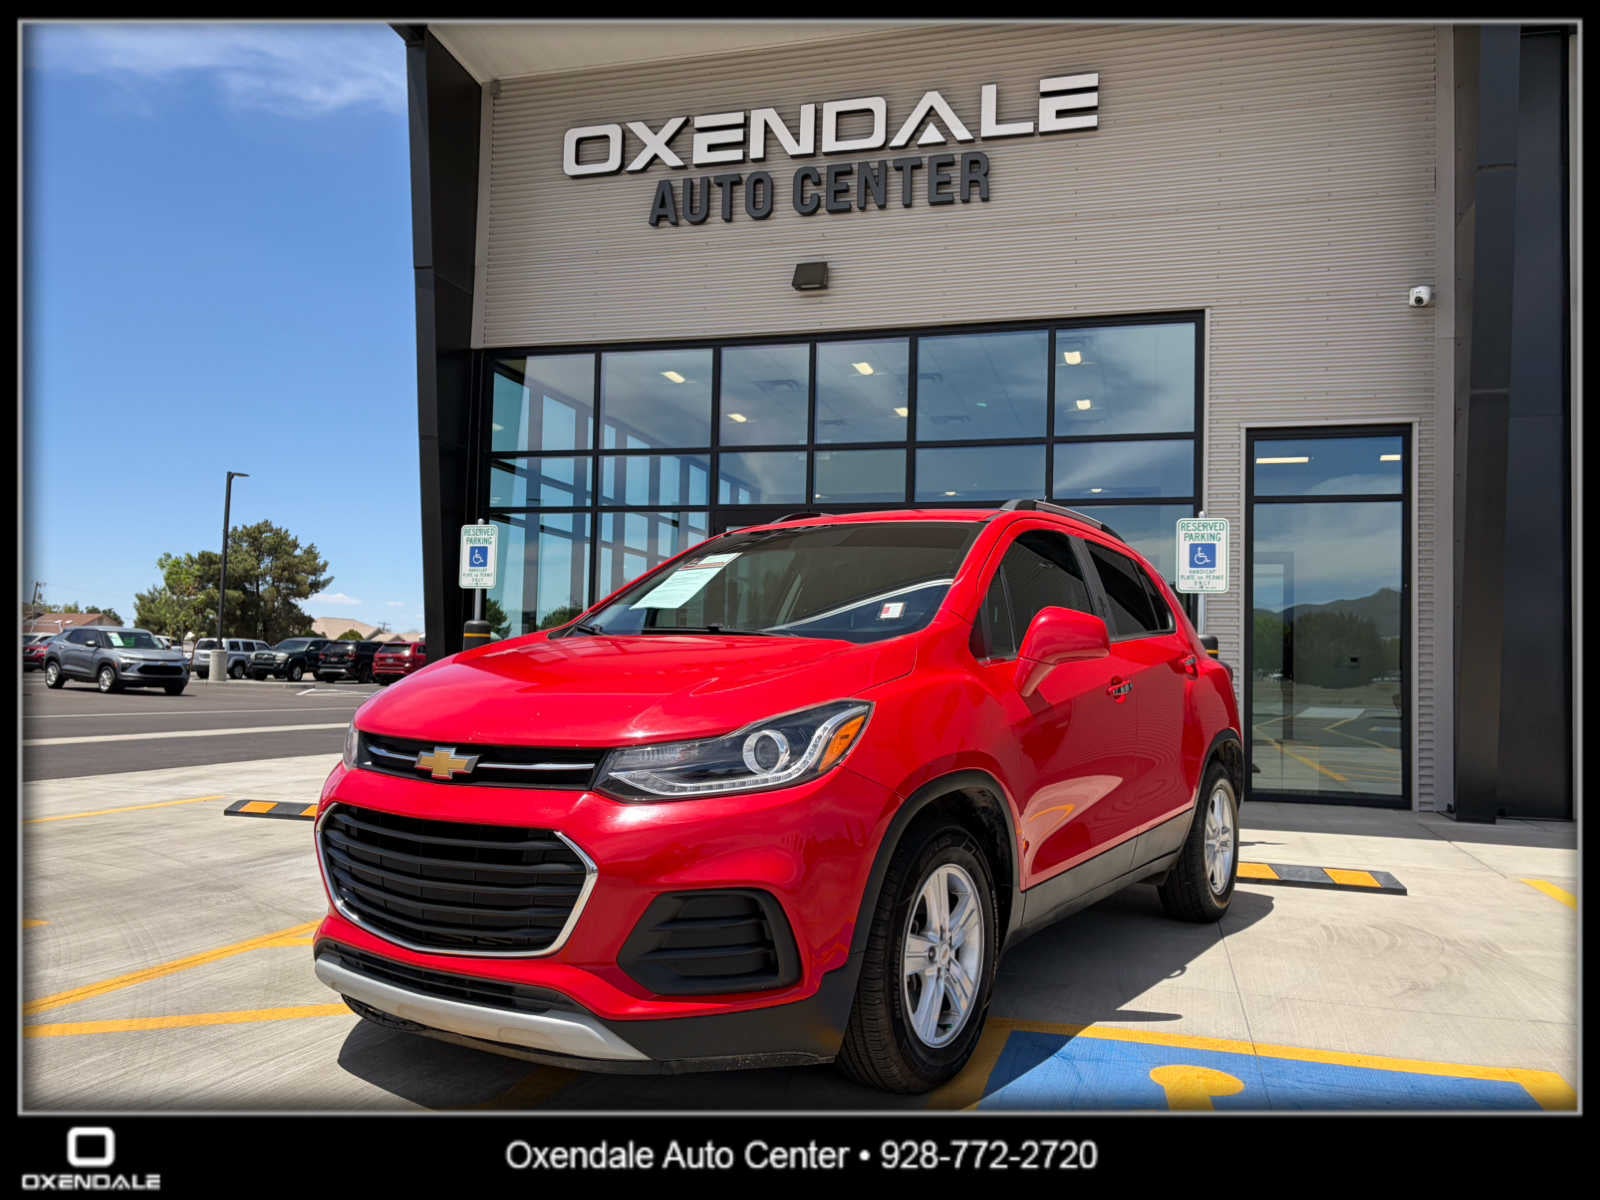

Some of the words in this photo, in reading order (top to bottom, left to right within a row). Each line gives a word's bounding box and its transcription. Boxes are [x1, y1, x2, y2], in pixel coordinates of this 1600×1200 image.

[562, 72, 1100, 179] OXENDALE
[648, 171, 775, 227] AUTO
[792, 150, 991, 216] CENTER
[464, 527, 496, 536] RESERVED
[1180, 522, 1225, 532] RESERVED
[465, 537, 493, 545] PARKING
[1183, 532, 1222, 542] PARKING
